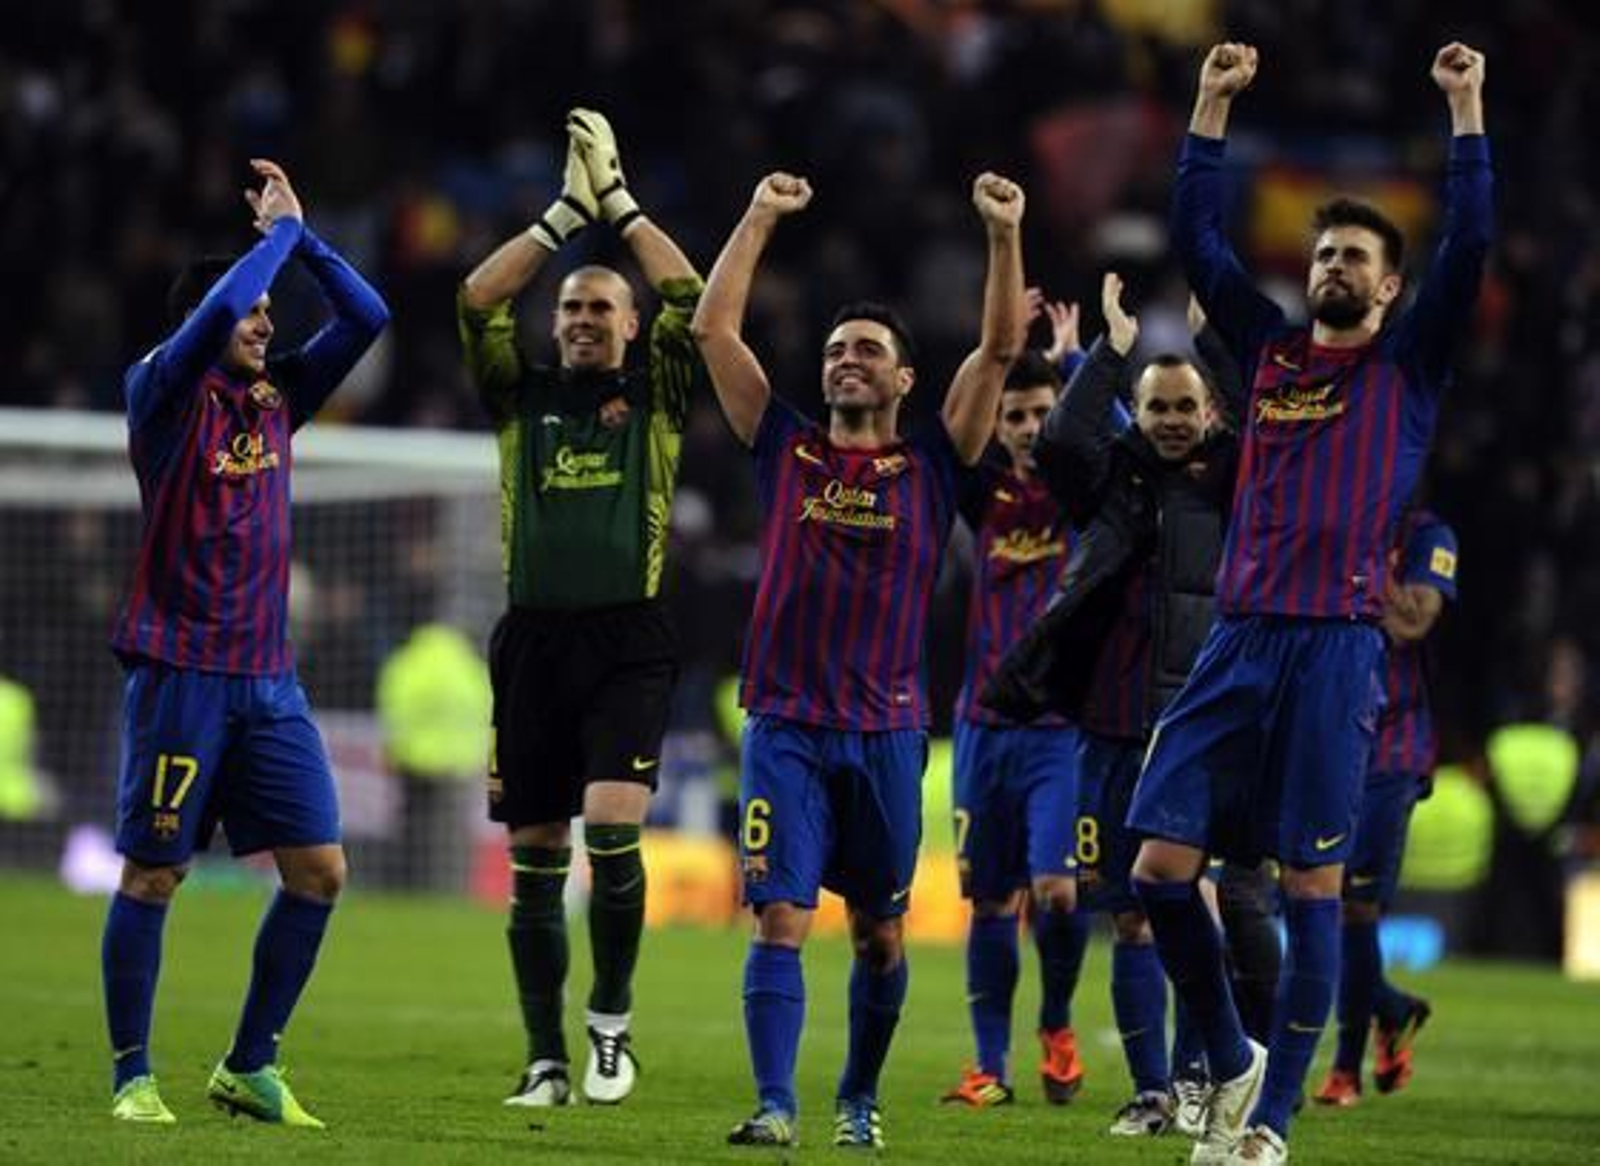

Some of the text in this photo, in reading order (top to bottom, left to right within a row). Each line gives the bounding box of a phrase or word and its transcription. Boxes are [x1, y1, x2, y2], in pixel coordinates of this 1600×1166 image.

[152, 754, 198, 808] 17
[744, 798, 771, 849] 6
[1077, 817, 1098, 864] 8
